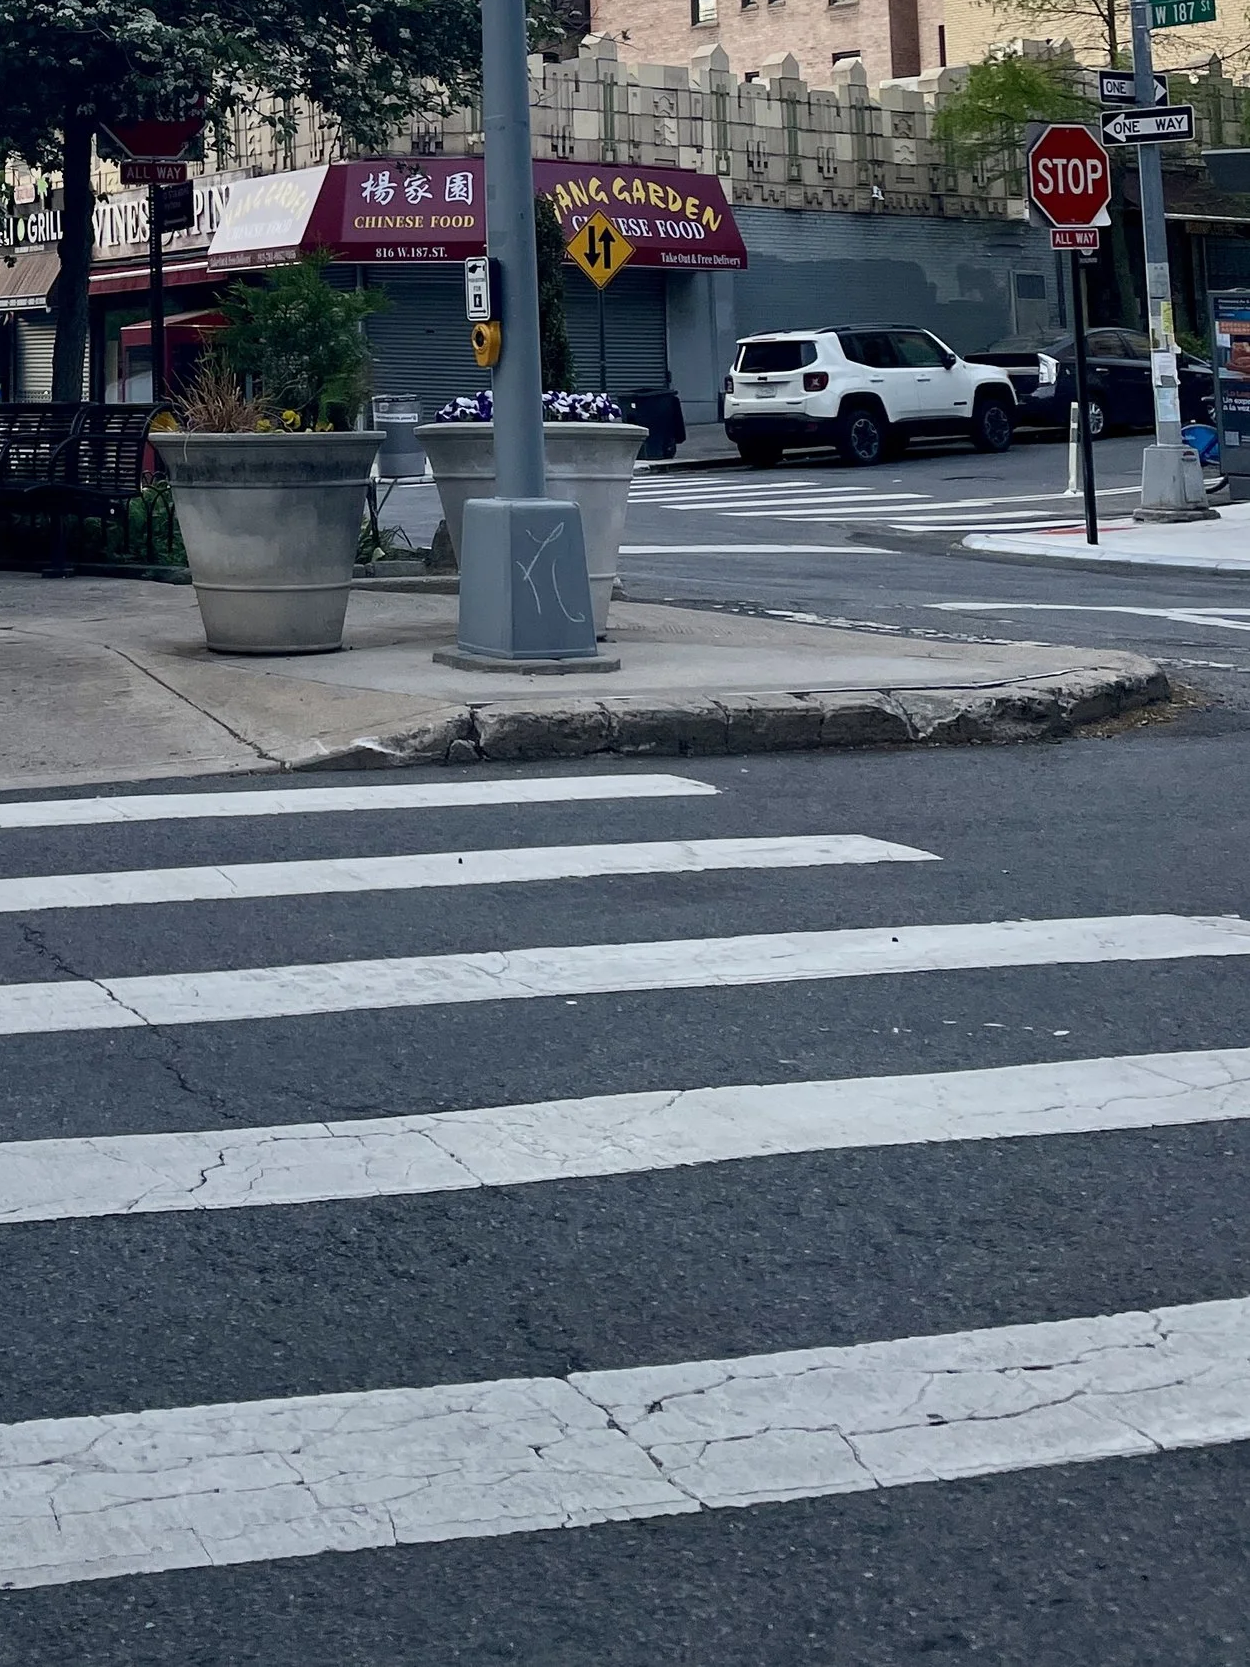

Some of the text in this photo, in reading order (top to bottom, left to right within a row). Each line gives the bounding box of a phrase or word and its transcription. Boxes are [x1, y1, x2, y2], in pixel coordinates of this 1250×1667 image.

[1155, 0, 1210, 24] W 187 St
[1105, 81, 1126, 94] ONE
[1113, 116, 1185, 135] ONE WAY
[126, 166, 182, 179] ALL WAY
[1037, 158, 1103, 194] STOP
[360, 170, 474, 206] 楊家園
[612, 177, 722, 232] GARDEN
[27, 210, 64, 244] GRILL
[91, 199, 149, 248] VINES
[353, 215, 475, 230] CHINESE FOOD
[571, 214, 705, 239] CESE FOOD
[1055, 232, 1095, 245] ALL WAY
[375, 247, 394, 258] 816
[661, 252, 741, 267] Take Out & Free Delivery
